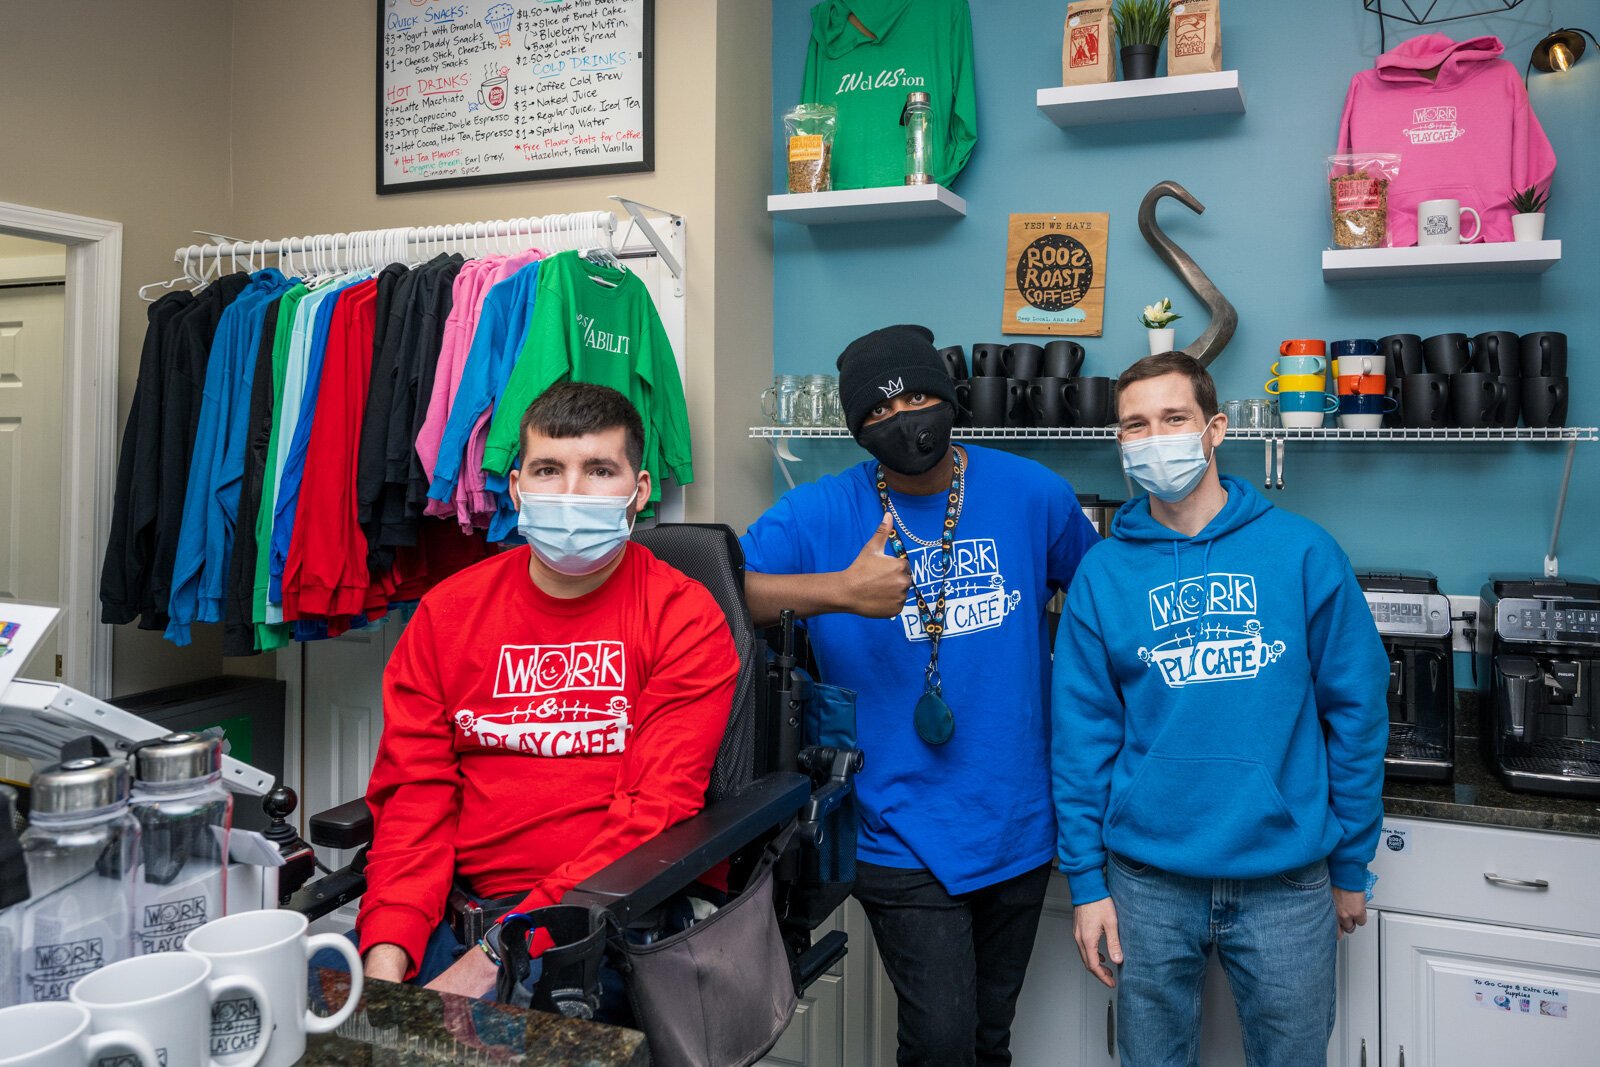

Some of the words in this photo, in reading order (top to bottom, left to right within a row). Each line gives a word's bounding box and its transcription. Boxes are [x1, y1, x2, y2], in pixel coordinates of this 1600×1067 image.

[516, 8, 542, 19] $4.50
[516, 22, 530, 32] $3
[539, 18, 560, 28] Slice
[573, 10, 598, 20] Bundt
[385, 34, 396, 44] $3
[403, 27, 428, 43] Yogurt
[432, 24, 448, 36] with
[450, 18, 482, 34] Granola
[539, 24, 588, 40] Blueberry
[592, 18, 628, 31] Muffin,
[385, 46, 396, 57] $2
[405, 44, 420, 55] Pop
[424, 38, 450, 50] Daddy
[453, 33, 484, 46] Snacks
[531, 38, 558, 52] Bagel
[561, 35, 580, 46] with
[584, 30, 616, 44] Spread
[1177, 46, 1202, 54] BLEND
[385, 60, 396, 72] $1
[404, 55, 430, 67] Cheese
[432, 50, 454, 62] Stick,
[416, 63, 439, 74] Scooby
[442, 58, 468, 68] Snacks
[516, 54, 544, 66] $2.50
[554, 46, 586, 58] Cookie
[532, 60, 566, 76] COLD
[387, 85, 411, 100] HOT
[514, 86, 526, 95] $4
[536, 81, 566, 94] Coffee
[570, 76, 592, 87] Cold
[596, 71, 623, 82] Brew
[400, 102, 419, 113] Latte
[422, 94, 464, 108] Macchiato
[514, 101, 528, 111] $3
[536, 94, 568, 108] Naked
[572, 89, 598, 101] Juice
[413, 109, 456, 124] Cappuccino
[514, 116, 528, 125] $2
[537, 108, 568, 124] Regular
[599, 100, 620, 112] Iced
[624, 96, 640, 109] Tea
[1415, 108, 1456, 122] WORK
[385, 130, 394, 140] $3
[401, 126, 419, 138] Drip
[448, 120, 472, 130] Double
[474, 114, 510, 126] Espresso
[516, 130, 526, 140] $1
[536, 121, 574, 137] Sparkling
[578, 118, 610, 128] Water
[1412, 132, 1433, 142] PLAY
[385, 145, 395, 155] $2
[402, 142, 414, 152] Hot
[440, 134, 456, 144] Hot
[458, 132, 474, 142] Tea,
[475, 128, 514, 141] Espresso
[523, 142, 540, 152] Free
[544, 138, 569, 148] Flavor
[572, 136, 596, 146] Shots
[600, 132, 612, 142] for
[616, 130, 641, 140] Coffee
[531, 148, 572, 160] Hazelnut,
[574, 146, 600, 156] French
[603, 142, 633, 152] Vanilla
[402, 156, 414, 166] Hot
[417, 152, 428, 162] Tea
[408, 163, 436, 174] Organic
[465, 154, 480, 166] Earl
[424, 168, 457, 178] Cinnamon
[461, 165, 480, 174] Spice
[1338, 188, 1378, 198] GRANOLA
[1024, 268, 1086, 288] ROAST
[1026, 288, 1081, 304] COFFEE
[954, 594, 1000, 628] CAFÉ
[1152, 580, 1254, 624] WORK
[1202, 641, 1256, 676] CAFÉ
[504, 647, 622, 693] WORK
[535, 698, 559, 718] &
[146, 900, 205, 924] WORK
[38, 942, 100, 968] WORK
[34, 982, 64, 999] PLAY
[1504, 990, 1530, 998] Supplies
